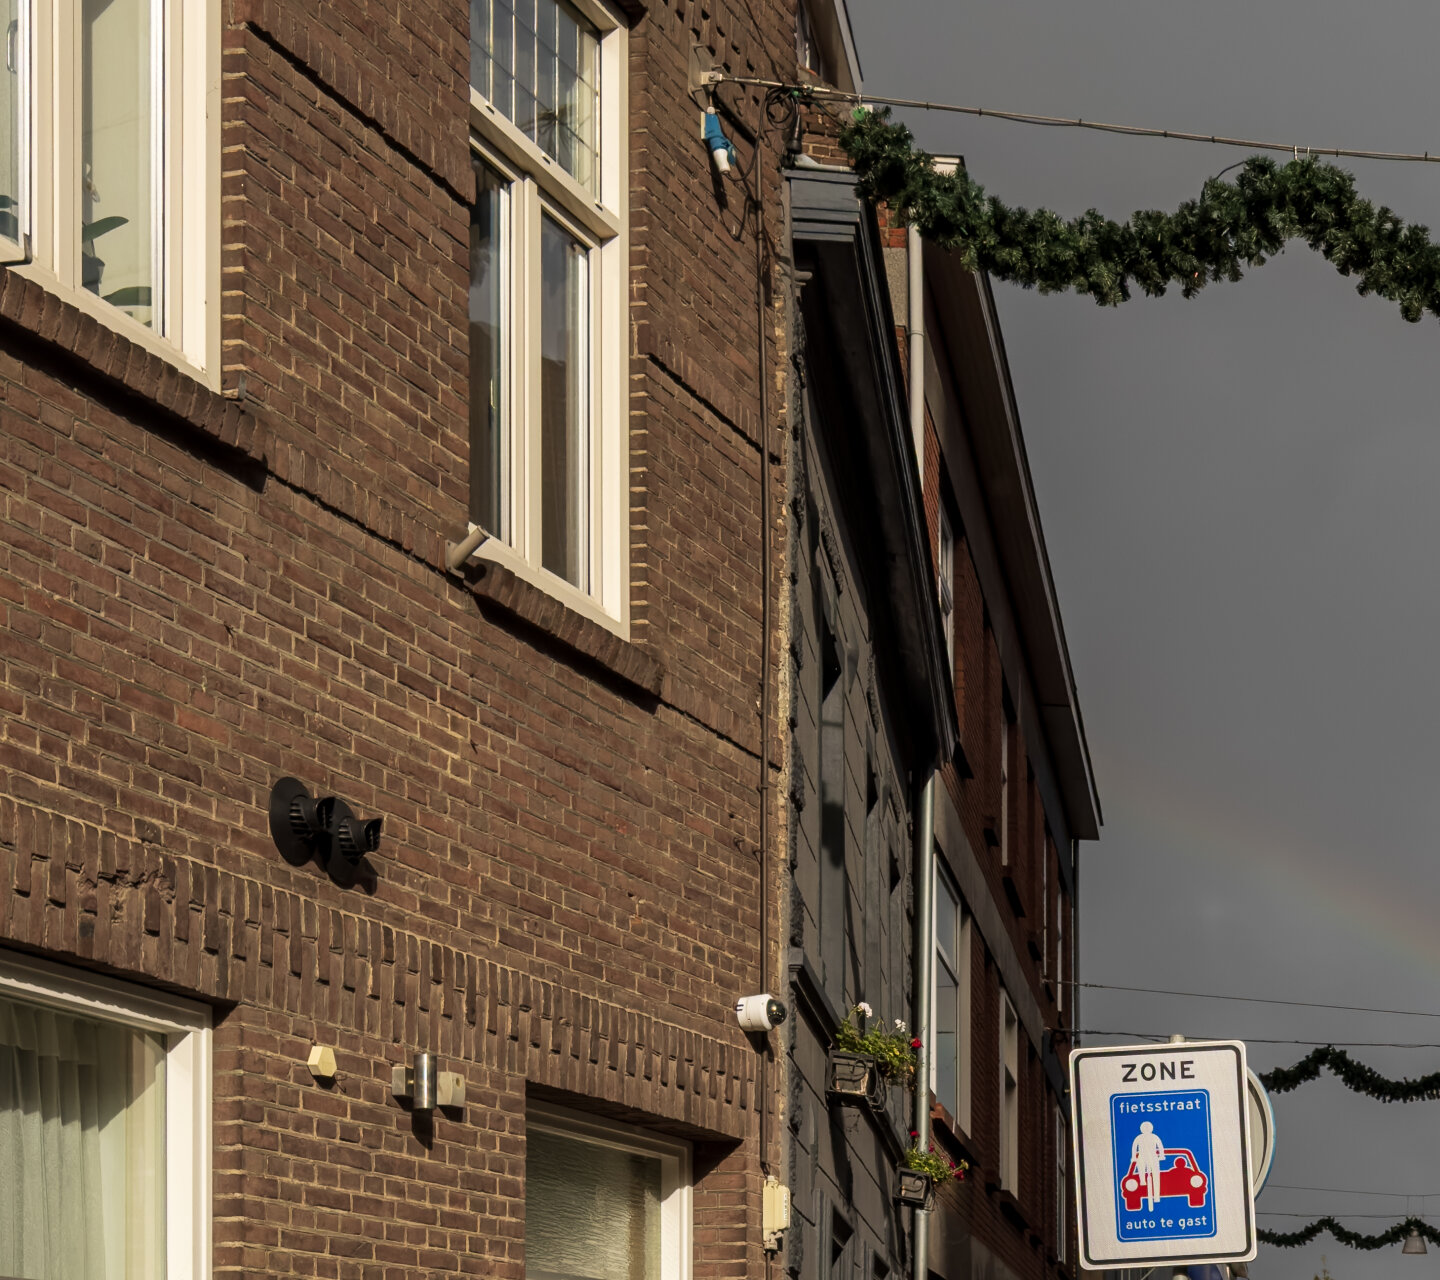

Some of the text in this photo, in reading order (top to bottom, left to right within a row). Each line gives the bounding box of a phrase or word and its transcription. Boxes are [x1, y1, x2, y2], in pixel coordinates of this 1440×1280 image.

[1121, 1060, 1196, 1083] ZONE
[1119, 1098, 1201, 1114] fietsstraat
[1125, 1215, 1208, 1230] auto te gast
